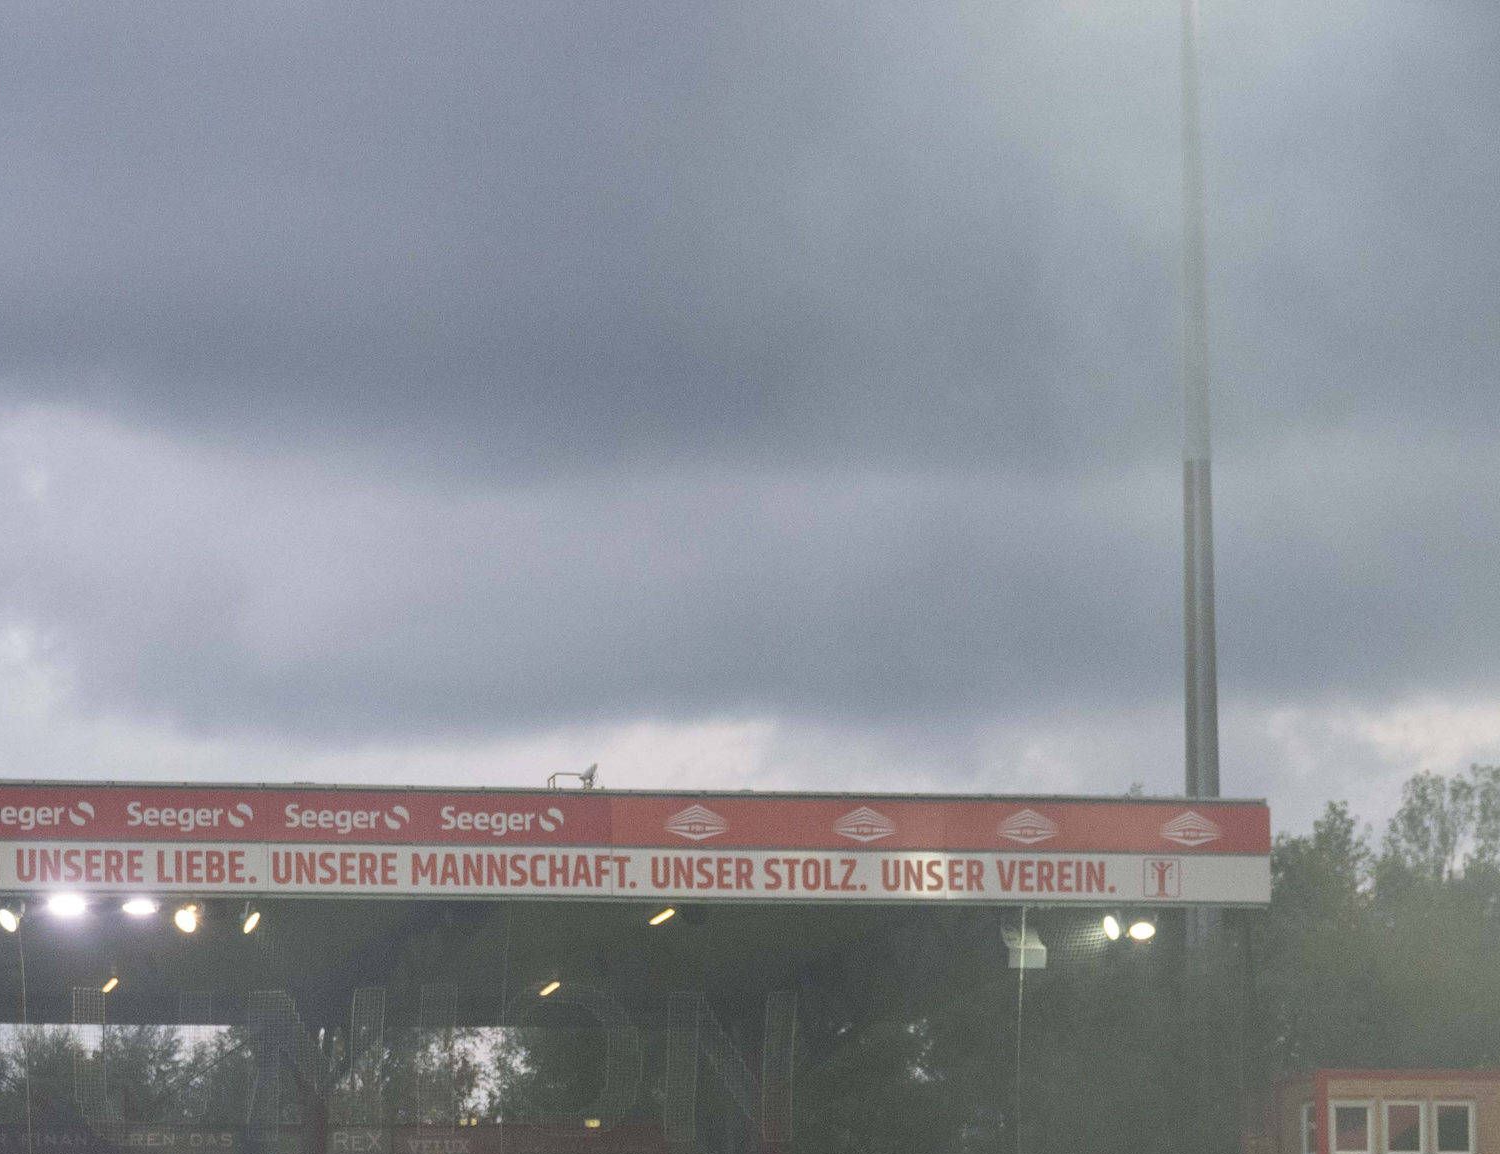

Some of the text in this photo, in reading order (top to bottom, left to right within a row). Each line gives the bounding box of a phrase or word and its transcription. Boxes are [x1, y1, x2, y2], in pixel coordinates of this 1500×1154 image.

[128, 801, 227, 832] Seeger
[285, 803, 384, 834] Seeger
[441, 806, 536, 836] Seeger
[15, 847, 1117, 895] UNSERE LIEBE. UNSERE MANNSCHAFT. UNSER STOLZ. UNSER VEREIN.
[407, 1137, 471, 1154] VELUX
